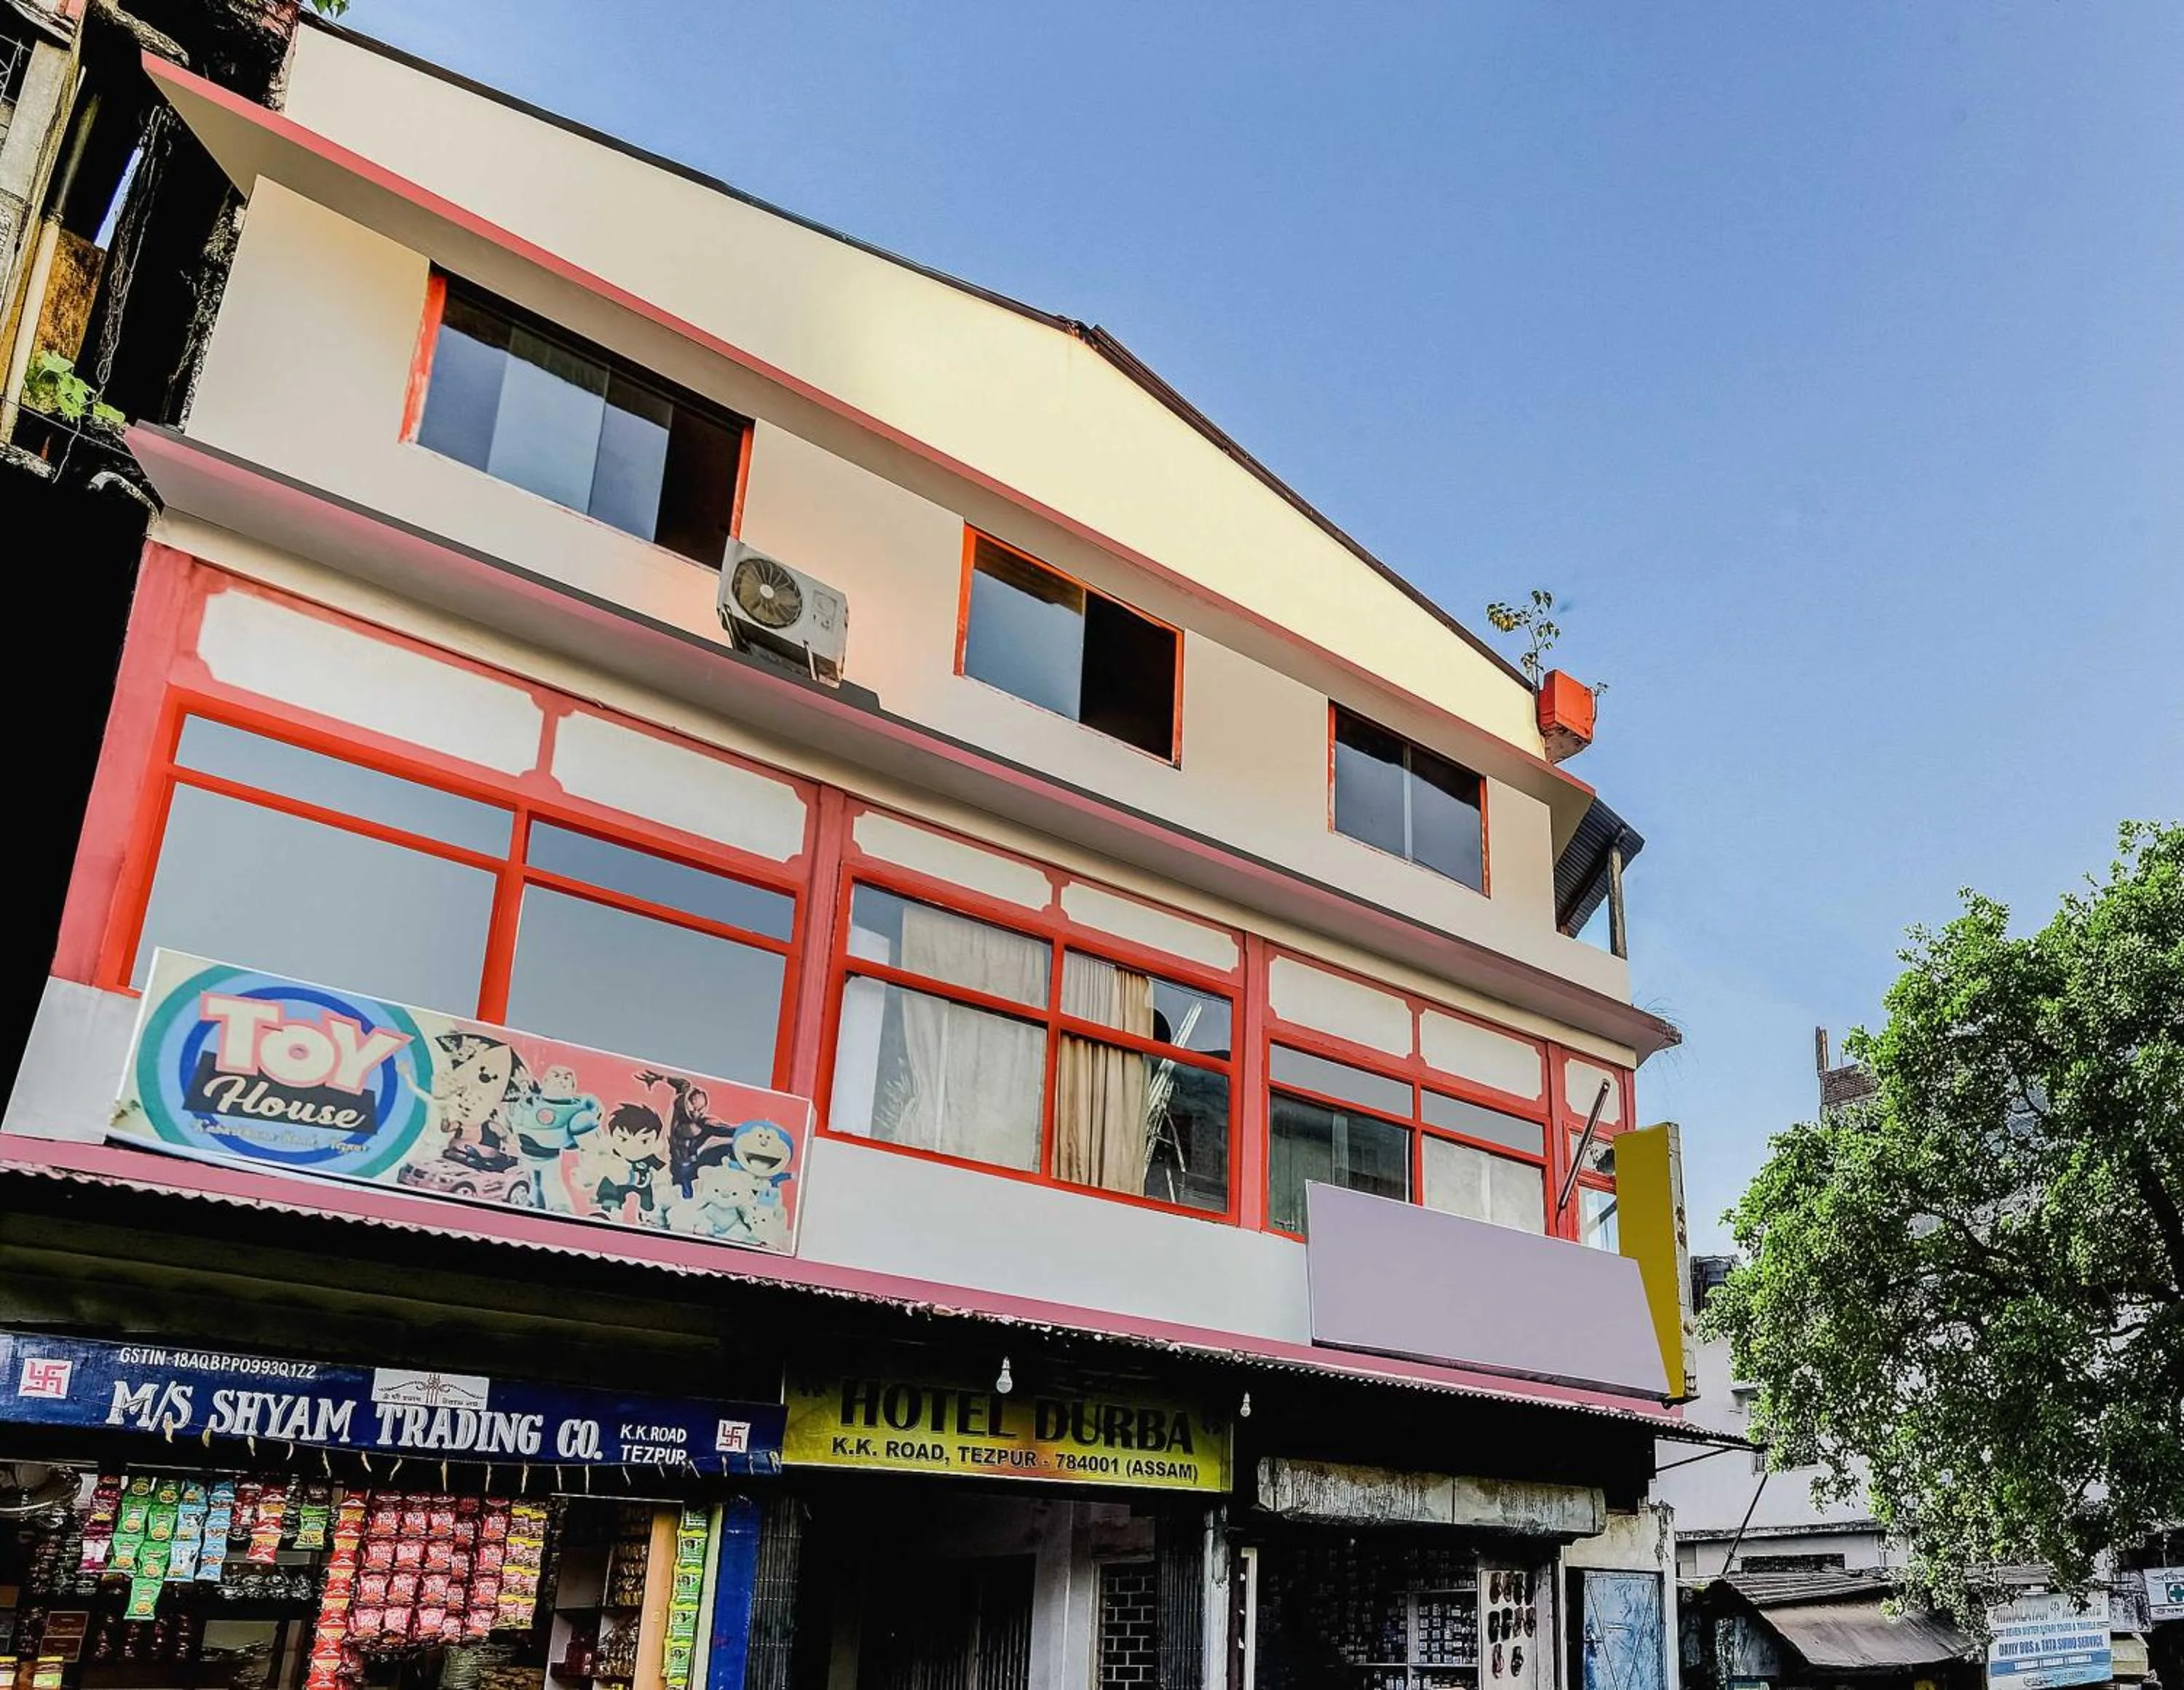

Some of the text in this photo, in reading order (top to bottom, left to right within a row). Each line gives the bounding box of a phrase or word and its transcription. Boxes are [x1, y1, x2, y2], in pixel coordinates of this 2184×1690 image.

[200, 991, 414, 1095] TOY
[203, 1075, 365, 1129] House
[106, 1381, 604, 1461] M/S SHYAM TRADING CO.
[840, 1376, 1195, 1455] HOTEL DURBA
[620, 1444, 687, 1466] TEZPUR
[831, 1436, 878, 1456] K.K.
[886, 1440, 950, 1467] ROAD,
[958, 1446, 1037, 1468] TEZPUR
[1055, 1453, 1120, 1474] 784001
[1125, 1459, 1198, 1484] (ASSAM)
[1998, 1642, 2018, 1656] DAILY
[2019, 1641, 2035, 1654] BUS
[2041, 1638, 2057, 1652] TATA
